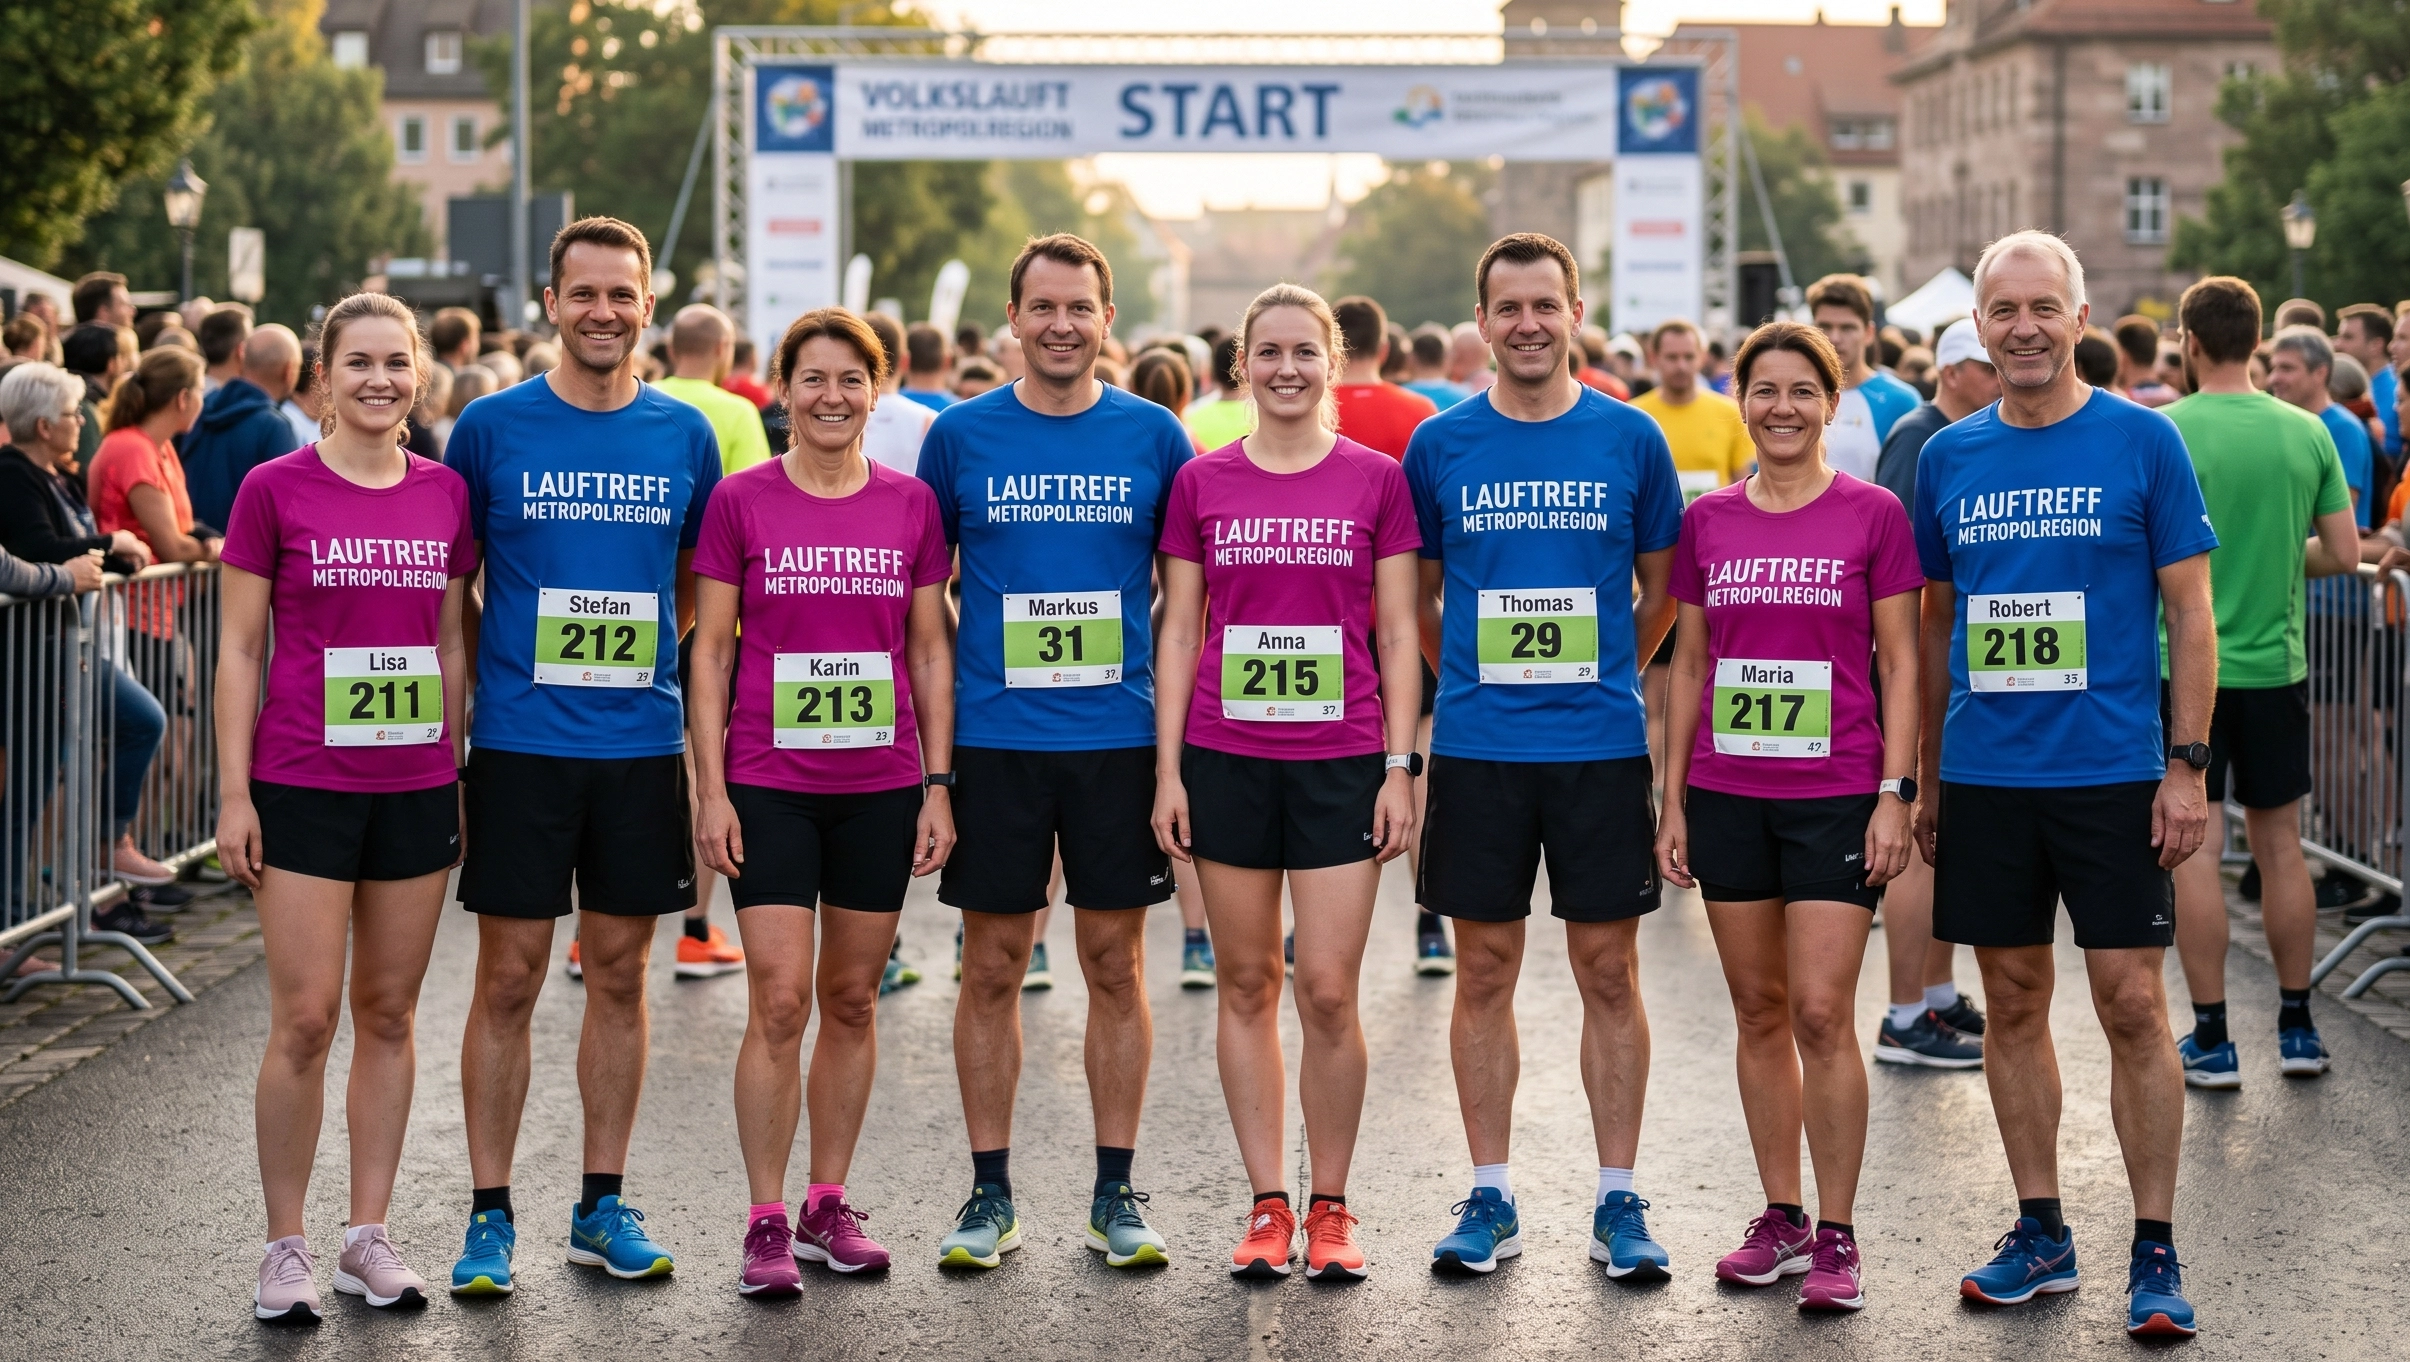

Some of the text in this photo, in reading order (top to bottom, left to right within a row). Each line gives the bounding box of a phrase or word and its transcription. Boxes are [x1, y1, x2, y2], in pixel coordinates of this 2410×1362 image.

[1119, 83, 1341, 138] START
[524, 472, 669, 503] LAUFTREFF
[988, 475, 1131, 501] LAUFTREFF
[1463, 481, 1607, 512] LAUFTREFF
[524, 502, 670, 525] METROPOLREGION
[989, 505, 1132, 523] METROPOLREGION
[1960, 487, 2101, 524] LAUFTREFF
[1215, 518, 1354, 544] LAUFTREFF
[1463, 511, 1607, 532] METROPOLREGION
[1959, 518, 2100, 545] METROPOLREGION
[311, 538, 447, 567] LAUFTREFF
[765, 547, 902, 575] LAUFTREFF
[1216, 547, 1352, 566] METROPOLREGION
[313, 569, 447, 589] METROPOLREGION
[1708, 558, 1844, 586] LAUFTREFF
[766, 576, 903, 597] METROPOLREGION
[569, 595, 631, 615] Stefan
[1028, 598, 1099, 616] Markus
[1499, 594, 1574, 612] Thomas
[1989, 599, 2052, 618] Robert
[560, 623, 636, 661] 212
[1039, 626, 1082, 662] 31
[1257, 631, 1306, 650] Anna
[1511, 622, 1561, 658] 29
[1985, 627, 2059, 665] 218
[369, 652, 407, 671] Lisa
[810, 657, 860, 677] Karin
[1578, 667, 1591, 677] 29
[1741, 664, 1794, 684] Maria
[1243, 659, 1318, 695] 215
[350, 681, 418, 719] 211
[797, 686, 872, 722] 213
[1322, 705, 1336, 715] 37
[1730, 693, 1804, 731] 217
[875, 731, 888, 741] 23
